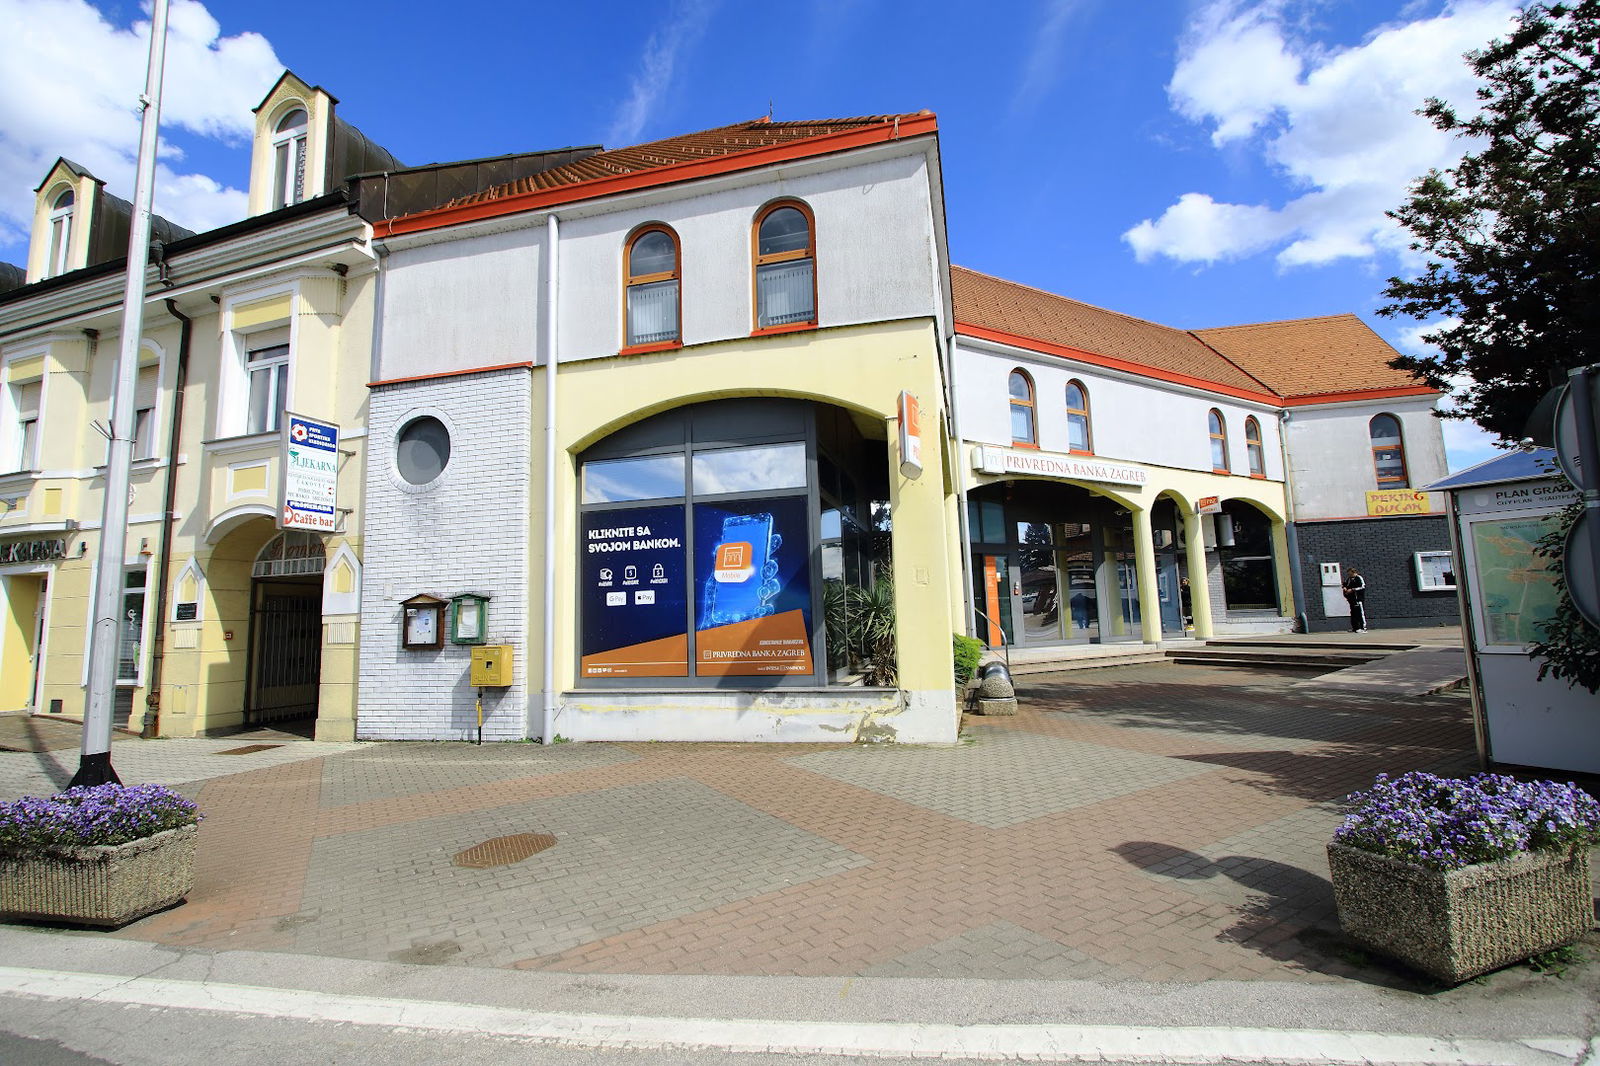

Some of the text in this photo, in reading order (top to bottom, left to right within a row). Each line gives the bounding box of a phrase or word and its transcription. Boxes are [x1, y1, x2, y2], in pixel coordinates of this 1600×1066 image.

[296, 456, 337, 473] LJEKARNA
[1006, 455, 1146, 483] PRIVREDNA BANKA ZAGREB
[1371, 491, 1424, 502] PEKING
[1496, 488, 1529, 499] PLAN
[294, 513, 334, 527] Caffe bar
[588, 526, 651, 540] KLIKNITE SA
[588, 538, 681, 553] SVOJOM BANKOM.
[712, 650, 751, 658] PRIVREDNA
[777, 649, 805, 657] ZAGREB
